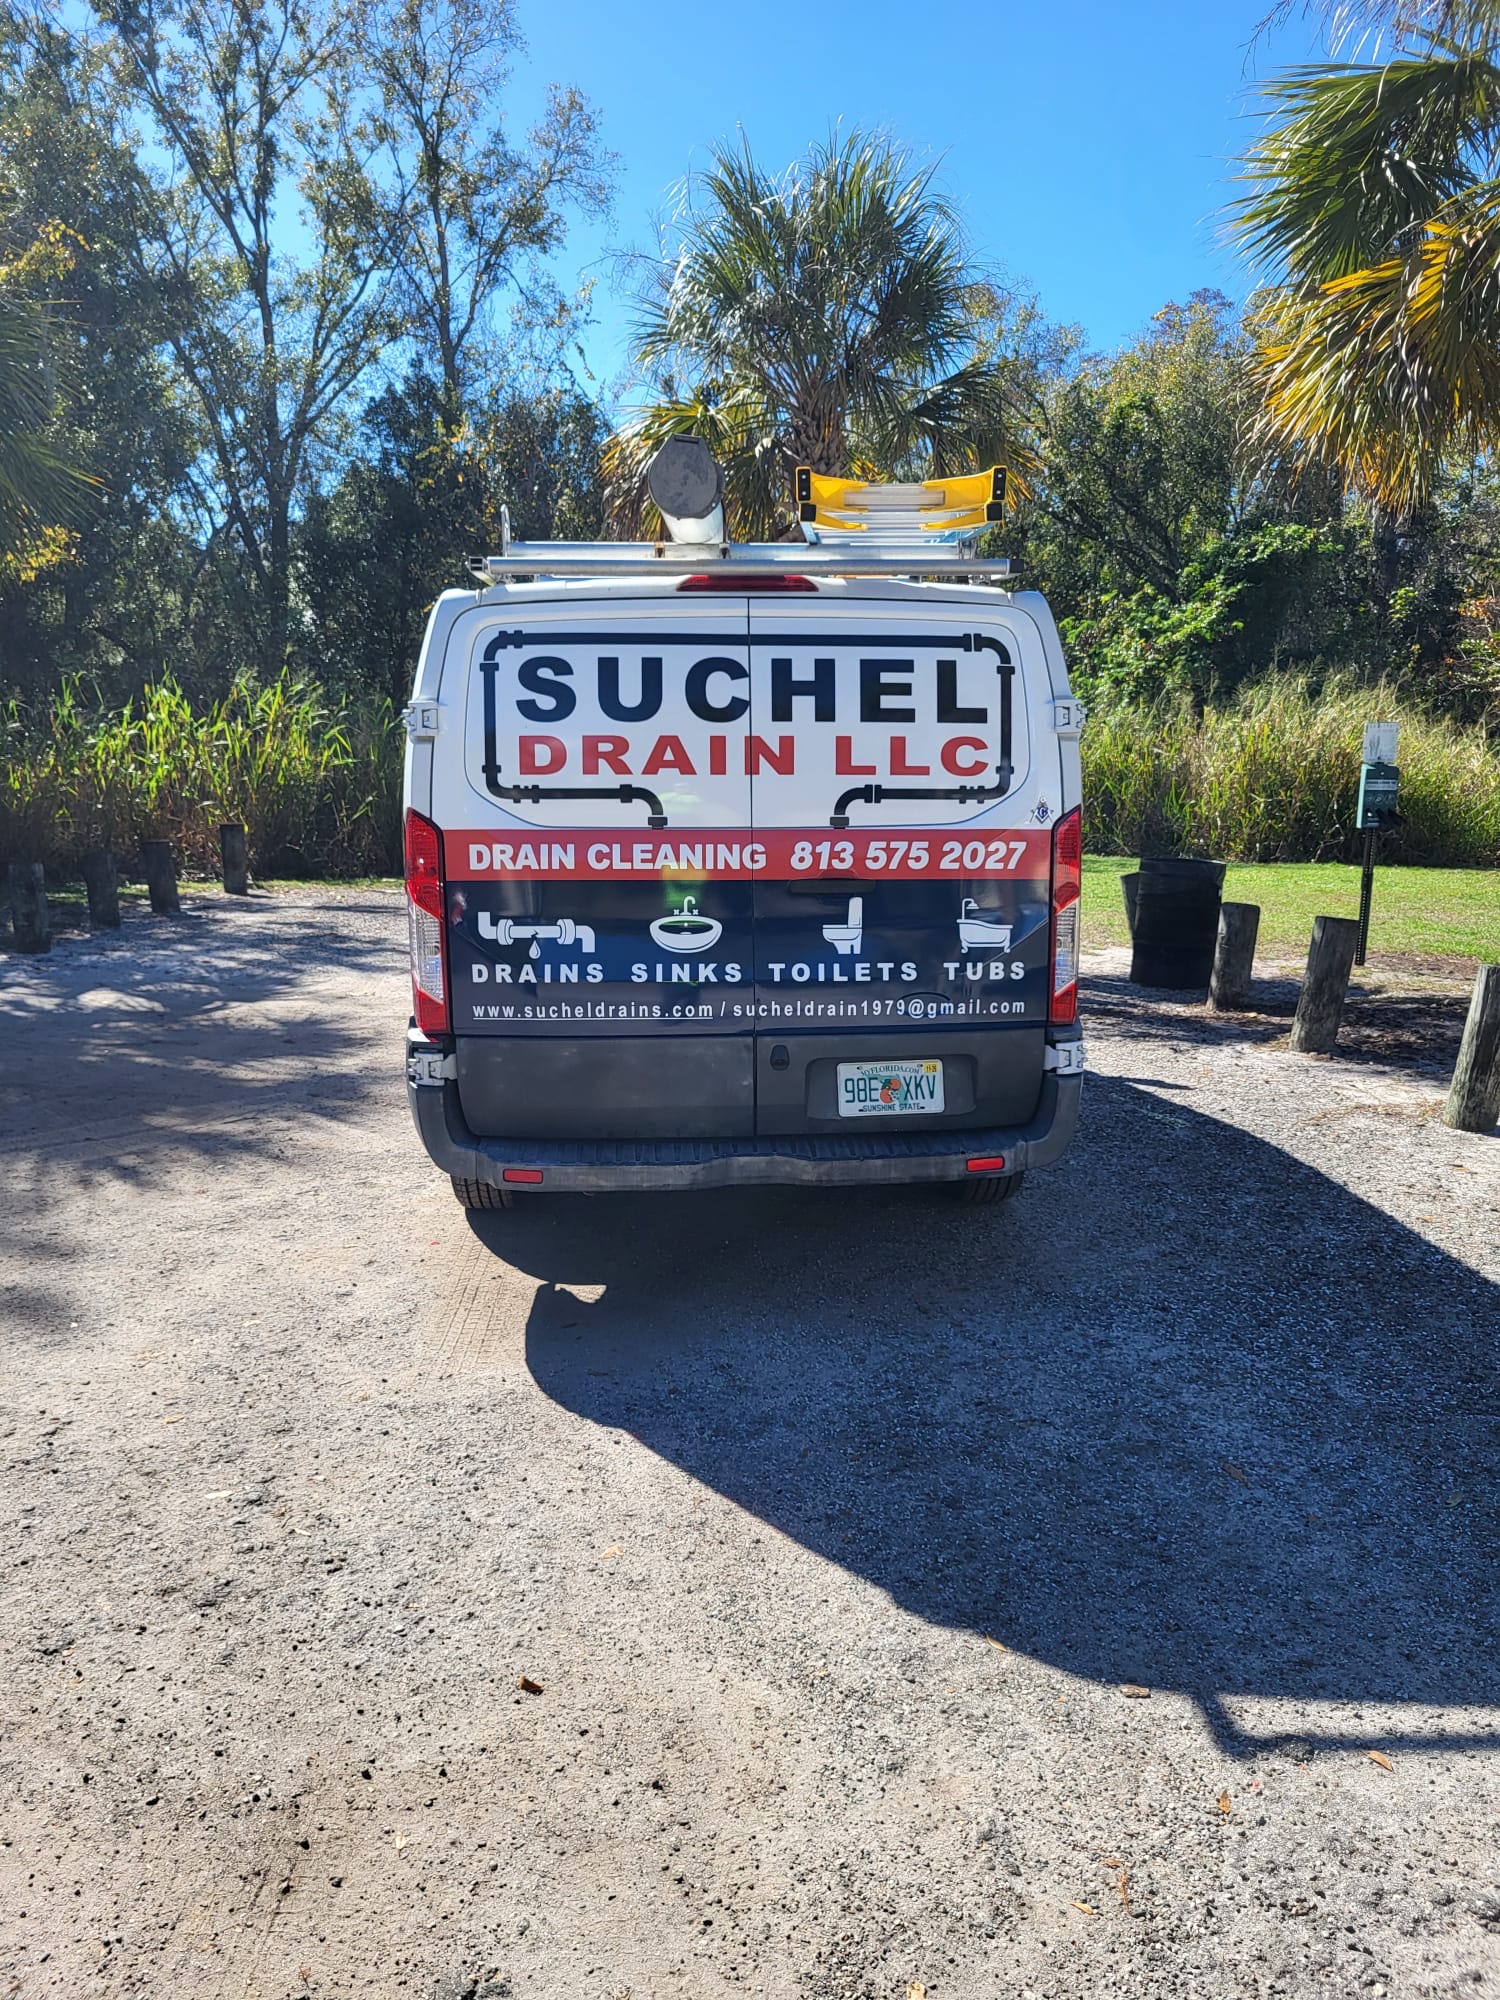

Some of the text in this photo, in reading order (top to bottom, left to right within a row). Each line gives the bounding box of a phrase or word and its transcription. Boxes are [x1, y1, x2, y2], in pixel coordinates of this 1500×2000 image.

[515, 656, 988, 723] SUCHEL
[518, 735, 989, 776] DRAIN LLC
[469, 841, 1027, 870] DRAIN CLEANING 813 575 2027
[472, 962, 1025, 983] DRAINS SINKS TOILETS TUBS
[472, 999, 1026, 1020] www.sucheldrains.com / sucheldrain1979@gmail.com
[863, 1104, 896, 1112] SUNSHINE
